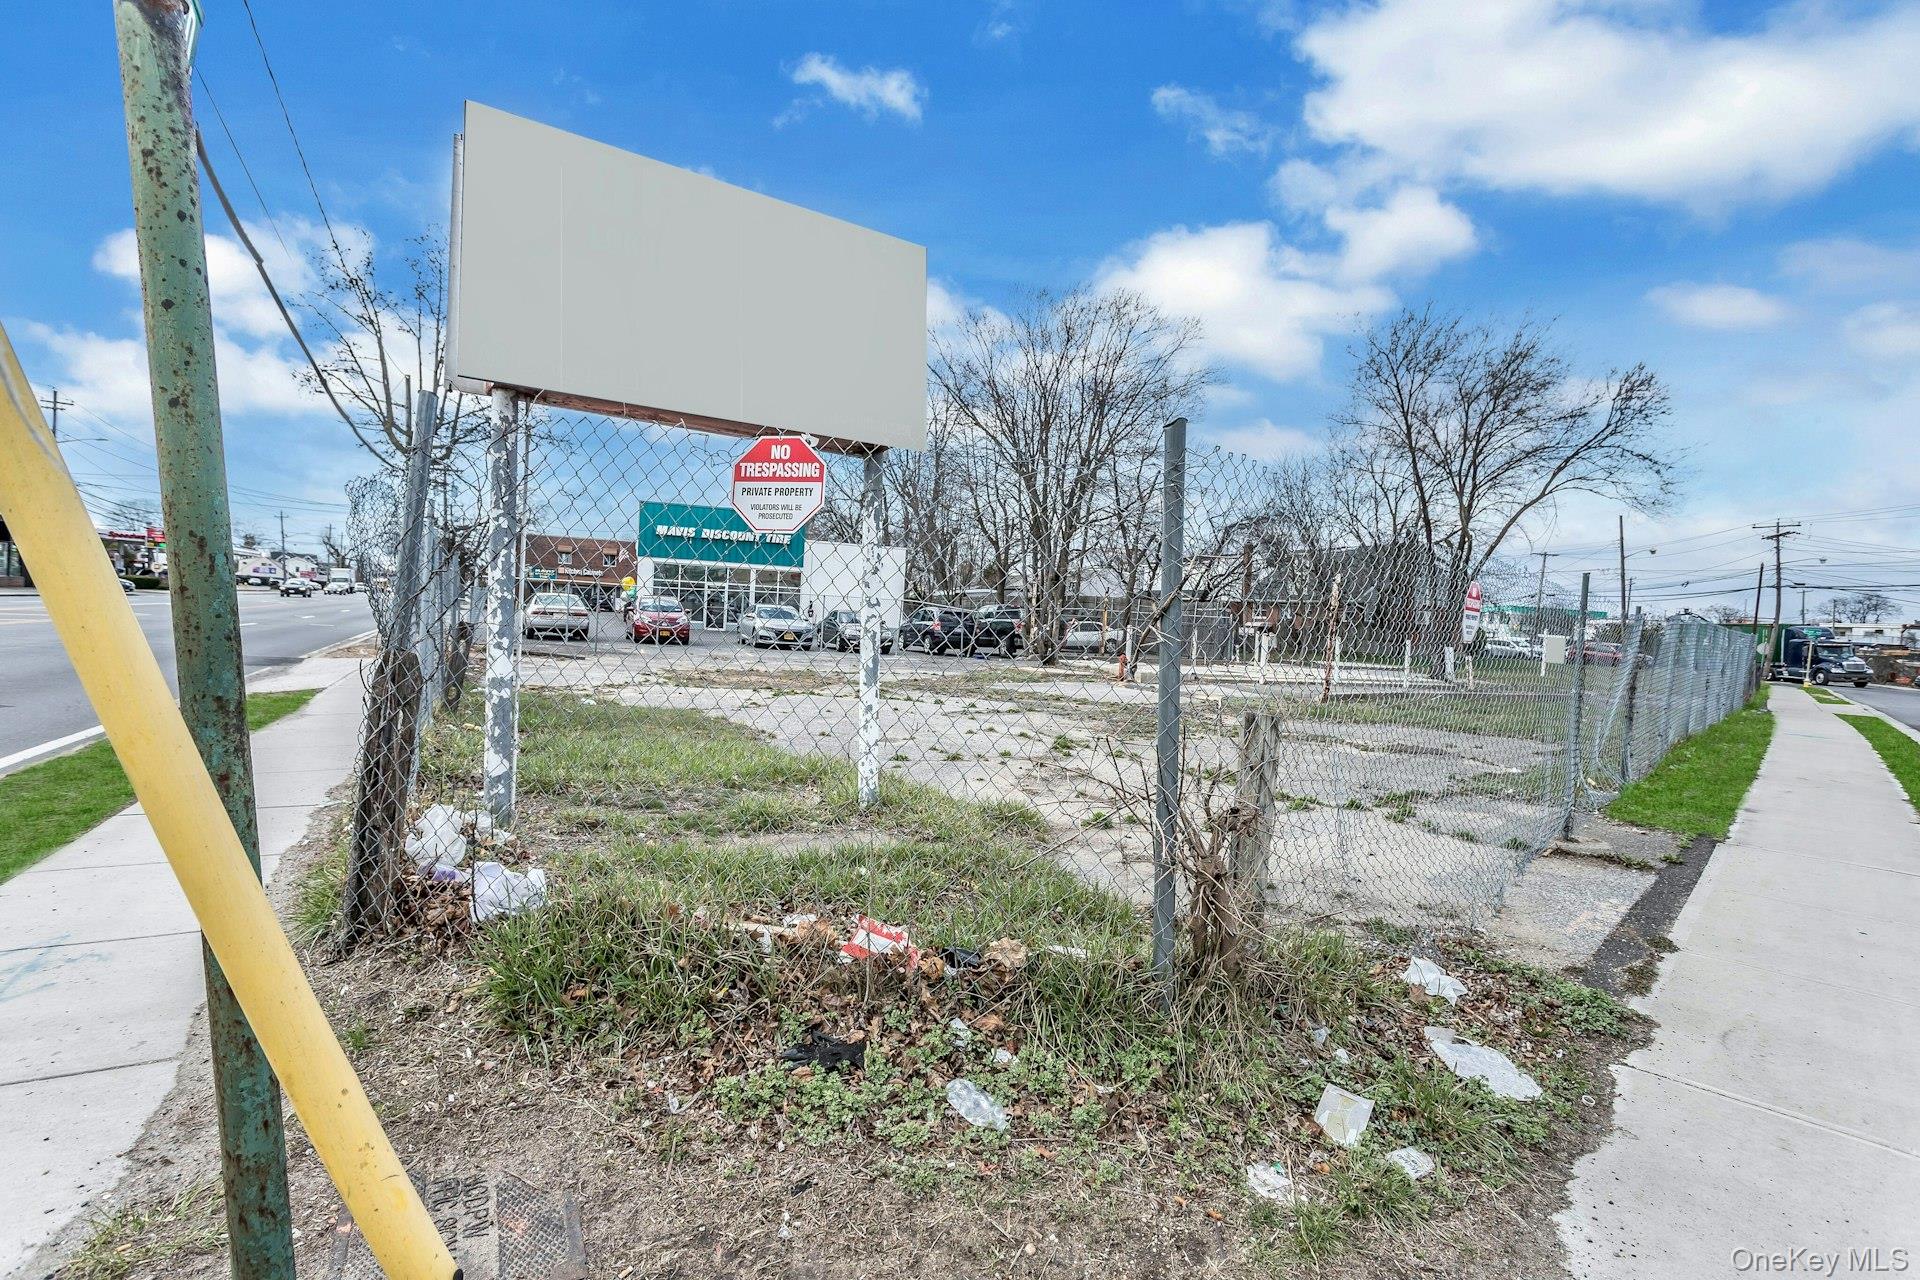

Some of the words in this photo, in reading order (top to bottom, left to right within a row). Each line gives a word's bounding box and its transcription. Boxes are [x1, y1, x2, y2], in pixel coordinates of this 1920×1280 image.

[770, 444, 791, 460] NO
[739, 462, 820, 478] TRESPASSING
[741, 487, 772, 496] PRIVATE
[774, 487, 814, 497] PROPERTY
[750, 503, 780, 511] VIOLATORS
[780, 503, 794, 511] WILL
[757, 512, 794, 520] PROSECUTED
[656, 524, 696, 538] MAVIS
[701, 527, 762, 543] DISCOUNT
[765, 532, 793, 545] TIRE
